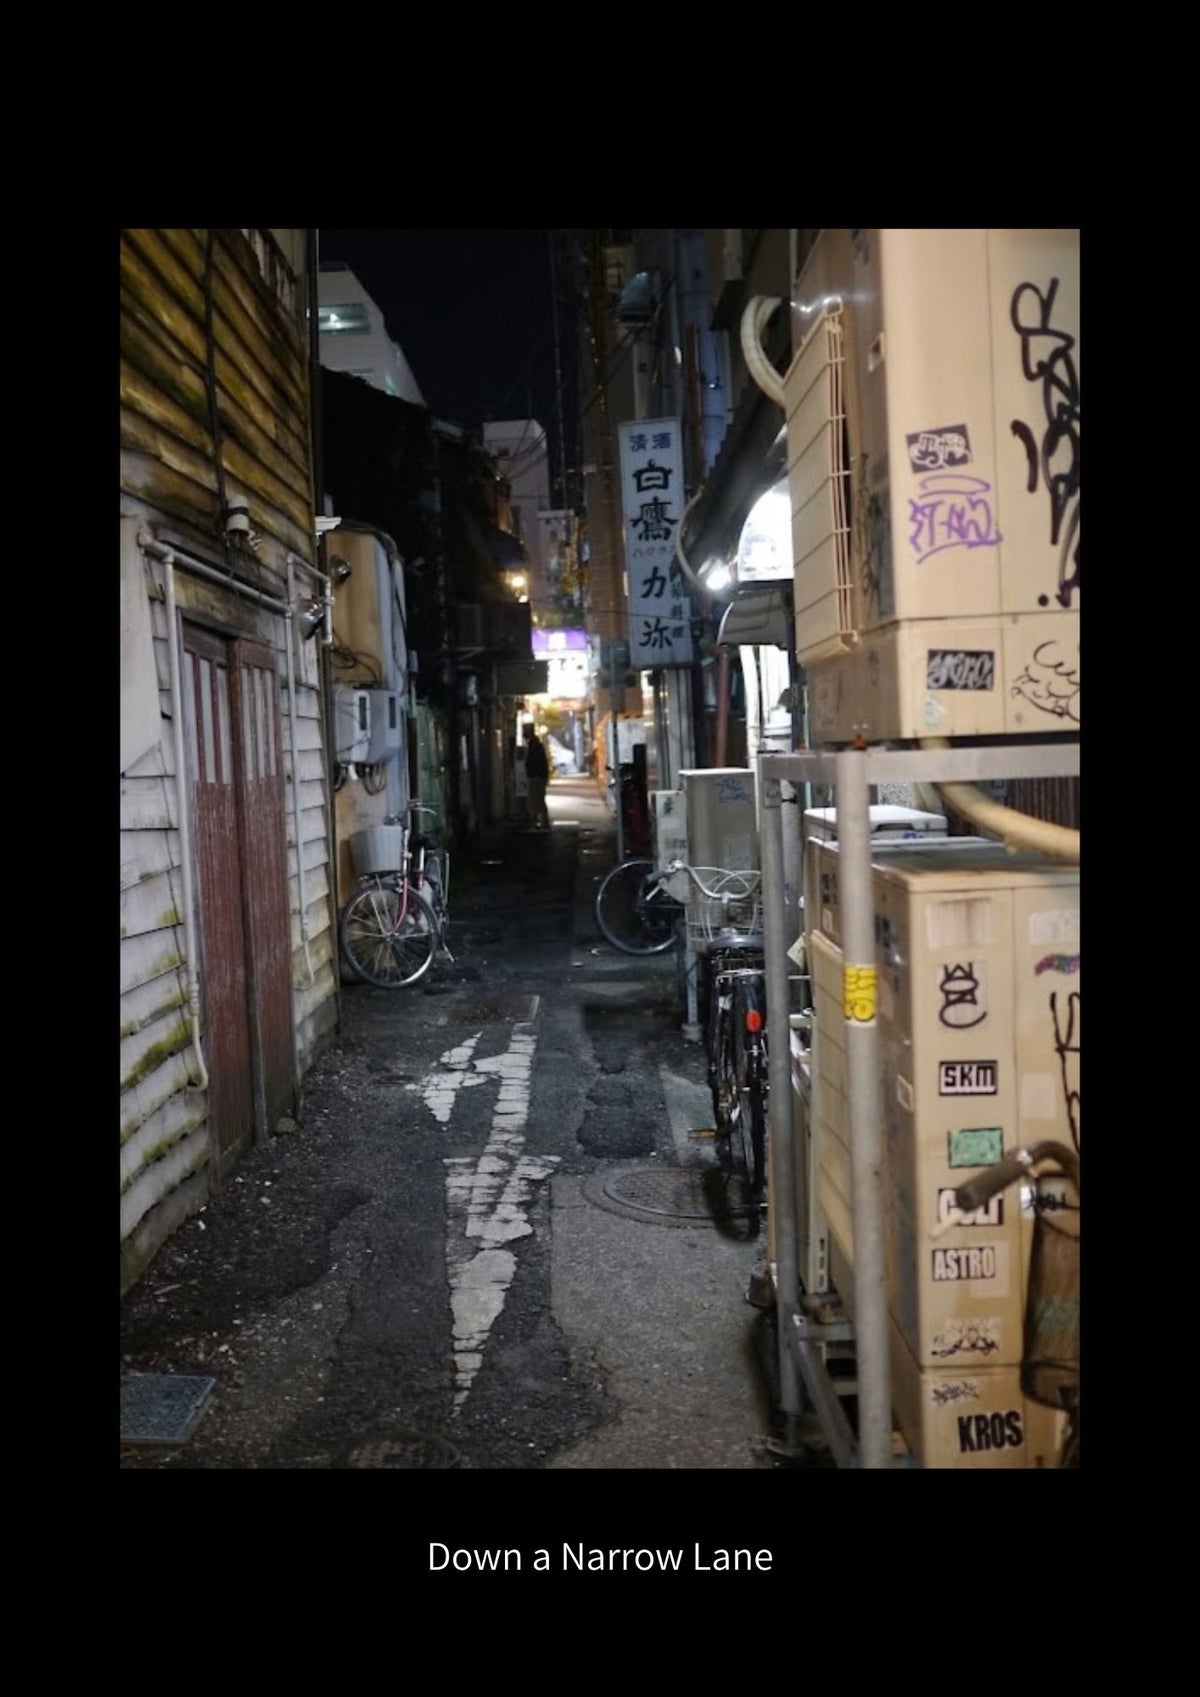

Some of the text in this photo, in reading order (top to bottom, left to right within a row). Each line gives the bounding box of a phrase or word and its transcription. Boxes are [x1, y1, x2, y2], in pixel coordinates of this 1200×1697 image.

[629, 432, 672, 452] 清酒
[629, 458, 679, 542] 白鷹
[933, 1248, 995, 1281] ASTRO
[957, 1411, 1023, 1453] KROS
